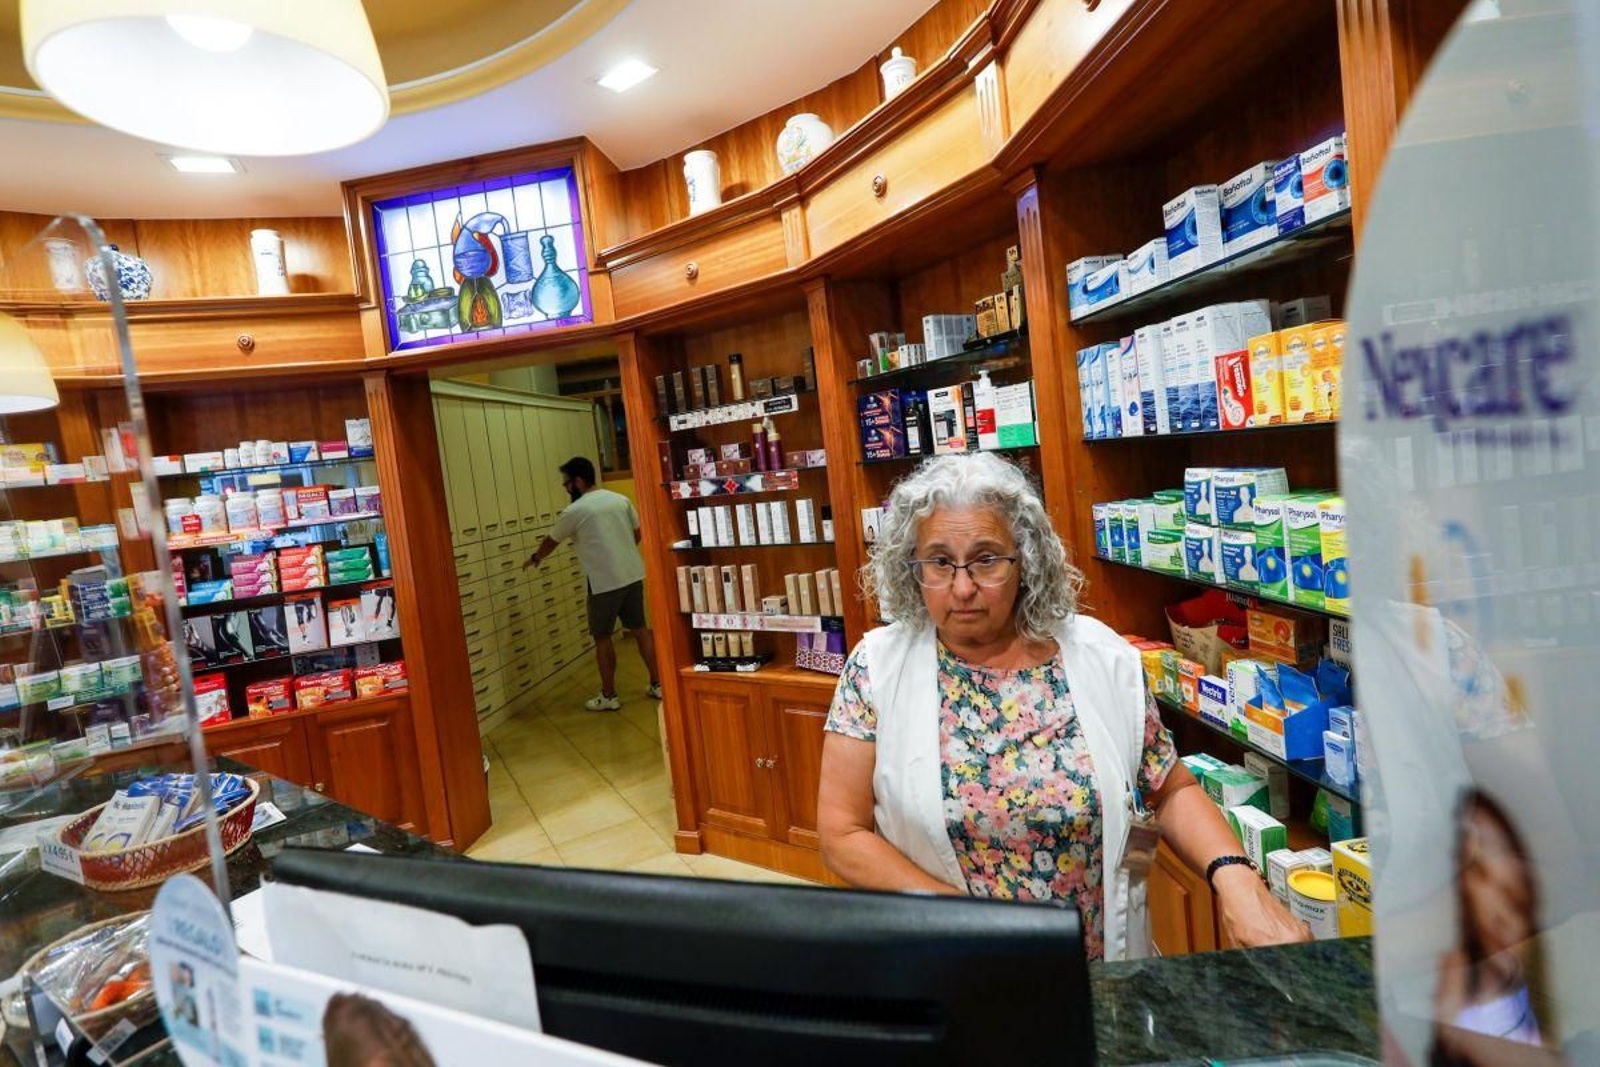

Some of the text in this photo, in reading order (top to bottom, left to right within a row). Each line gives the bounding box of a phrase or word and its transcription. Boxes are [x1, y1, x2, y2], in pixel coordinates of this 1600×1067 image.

[1254, 505, 1281, 516] Pharysol
[1288, 507, 1318, 520] Pharysol
[299, 675, 344, 687] ThermaCare
